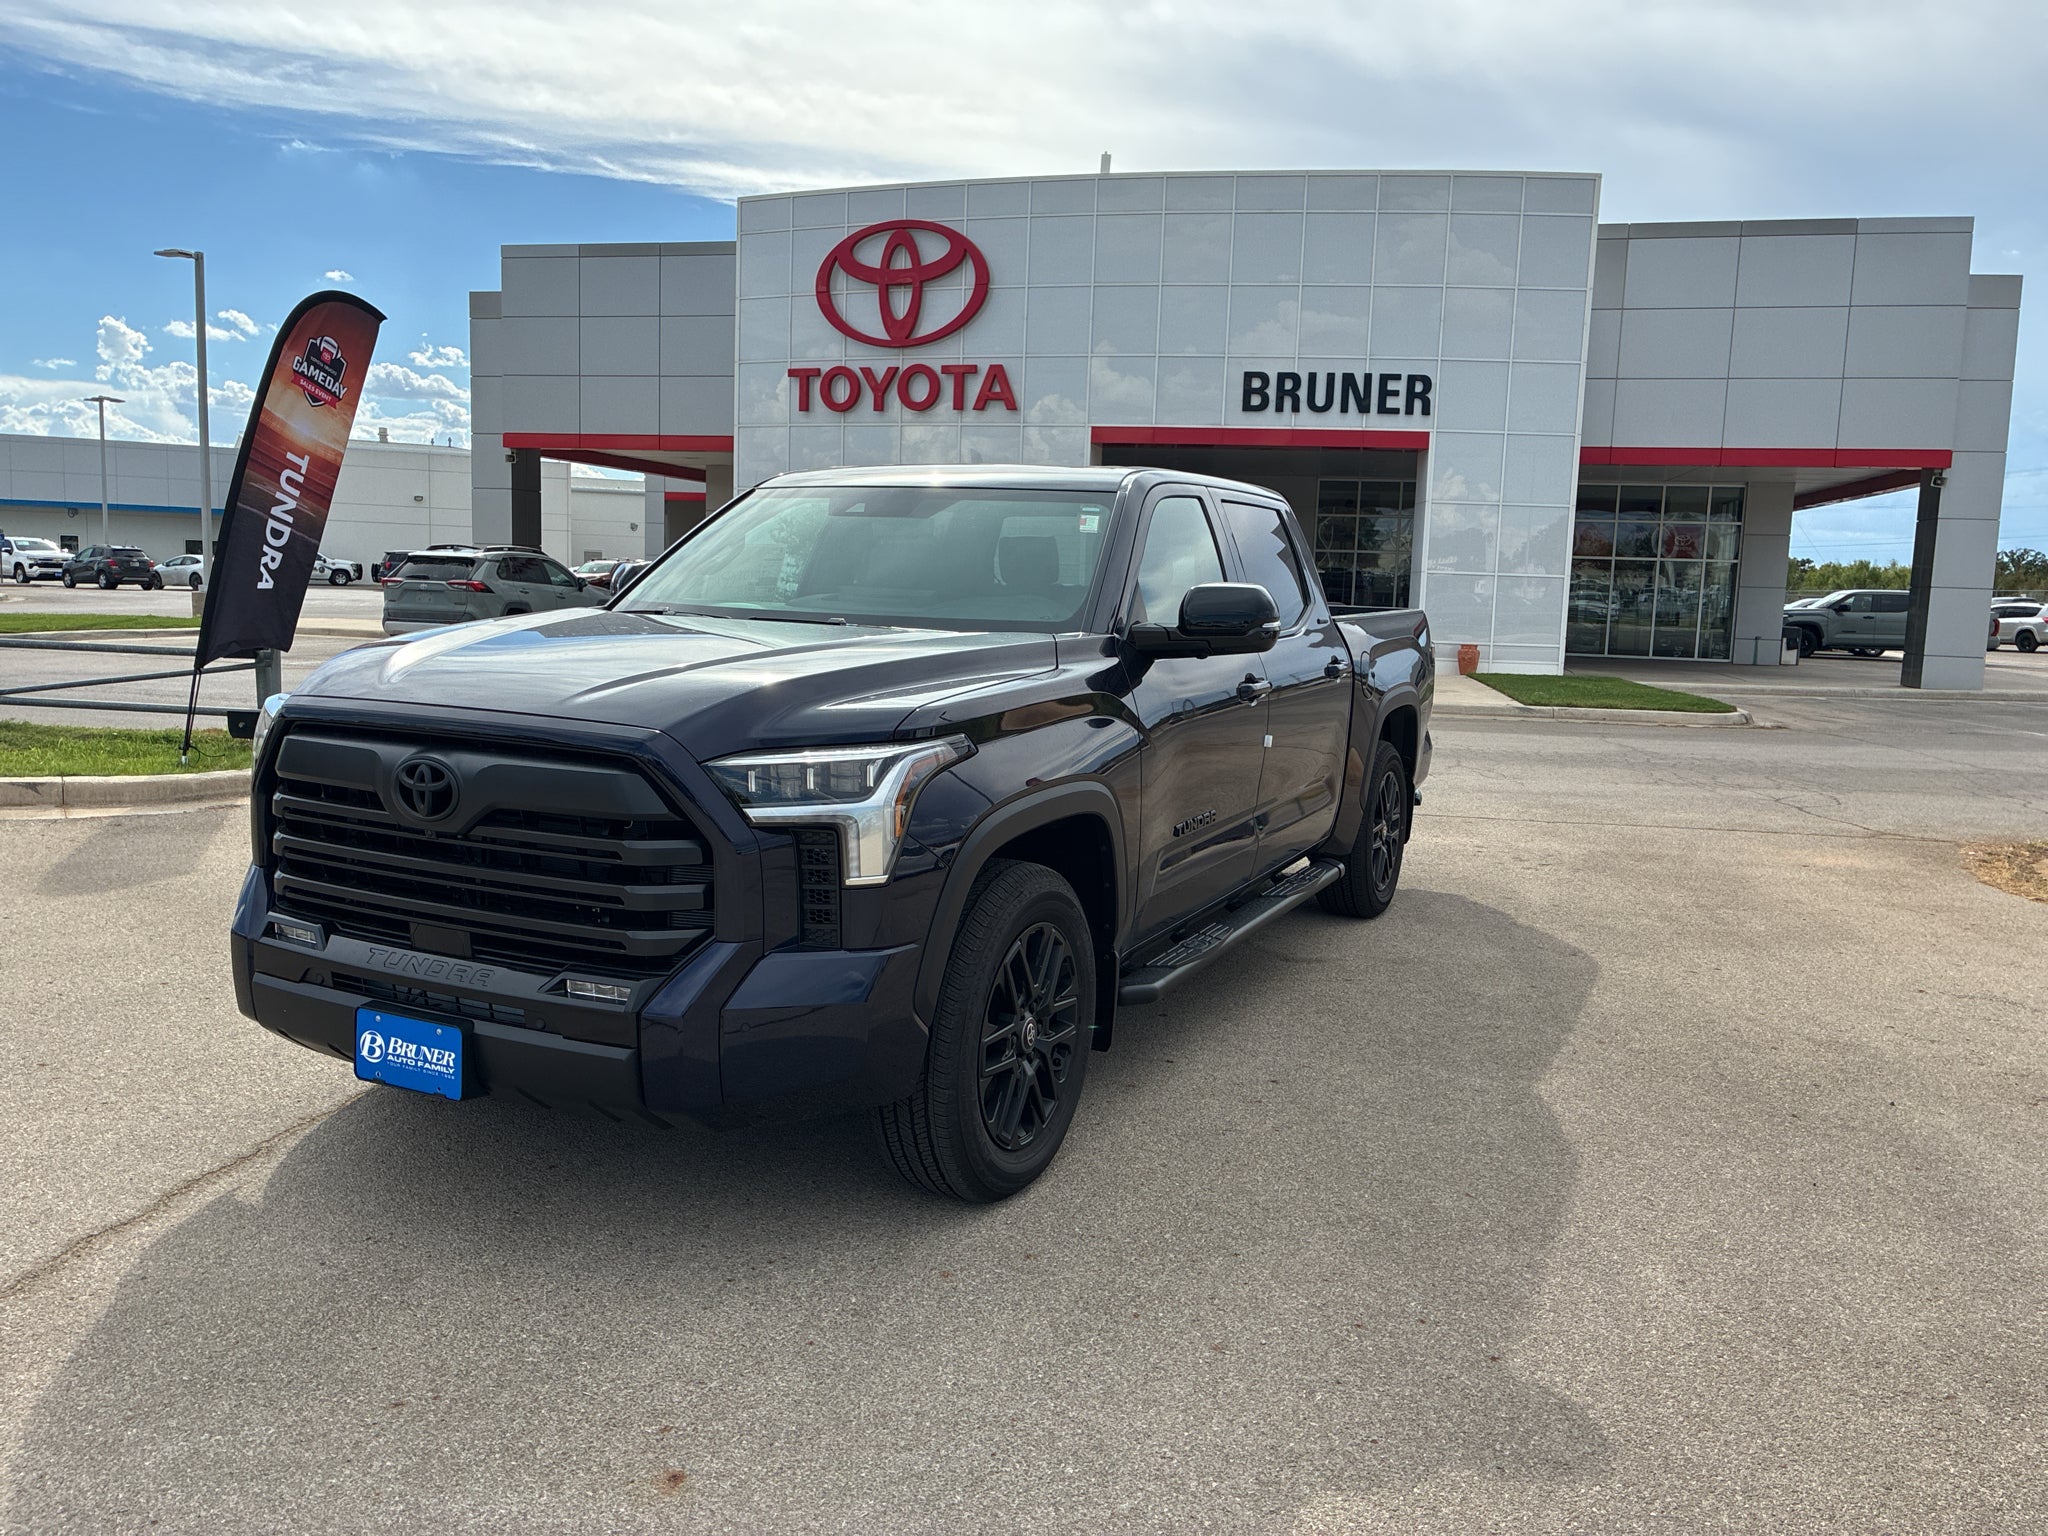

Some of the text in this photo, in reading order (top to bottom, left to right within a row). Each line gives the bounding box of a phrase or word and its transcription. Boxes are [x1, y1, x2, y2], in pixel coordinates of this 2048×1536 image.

[293, 355, 348, 399] GAMEDAY
[300, 378, 332, 402] SALES EVENT
[788, 363, 1018, 413] TOYOTA
[1242, 371, 1433, 416] BRUNER
[257, 451, 310, 589] TUNDRA
[1173, 809, 1216, 837] TUNDRA
[366, 947, 495, 987] TUNDRA
[360, 1033, 383, 1058] B
[387, 1036, 456, 1067] BRUNER
[387, 1054, 455, 1074] AUTO FAMILY
